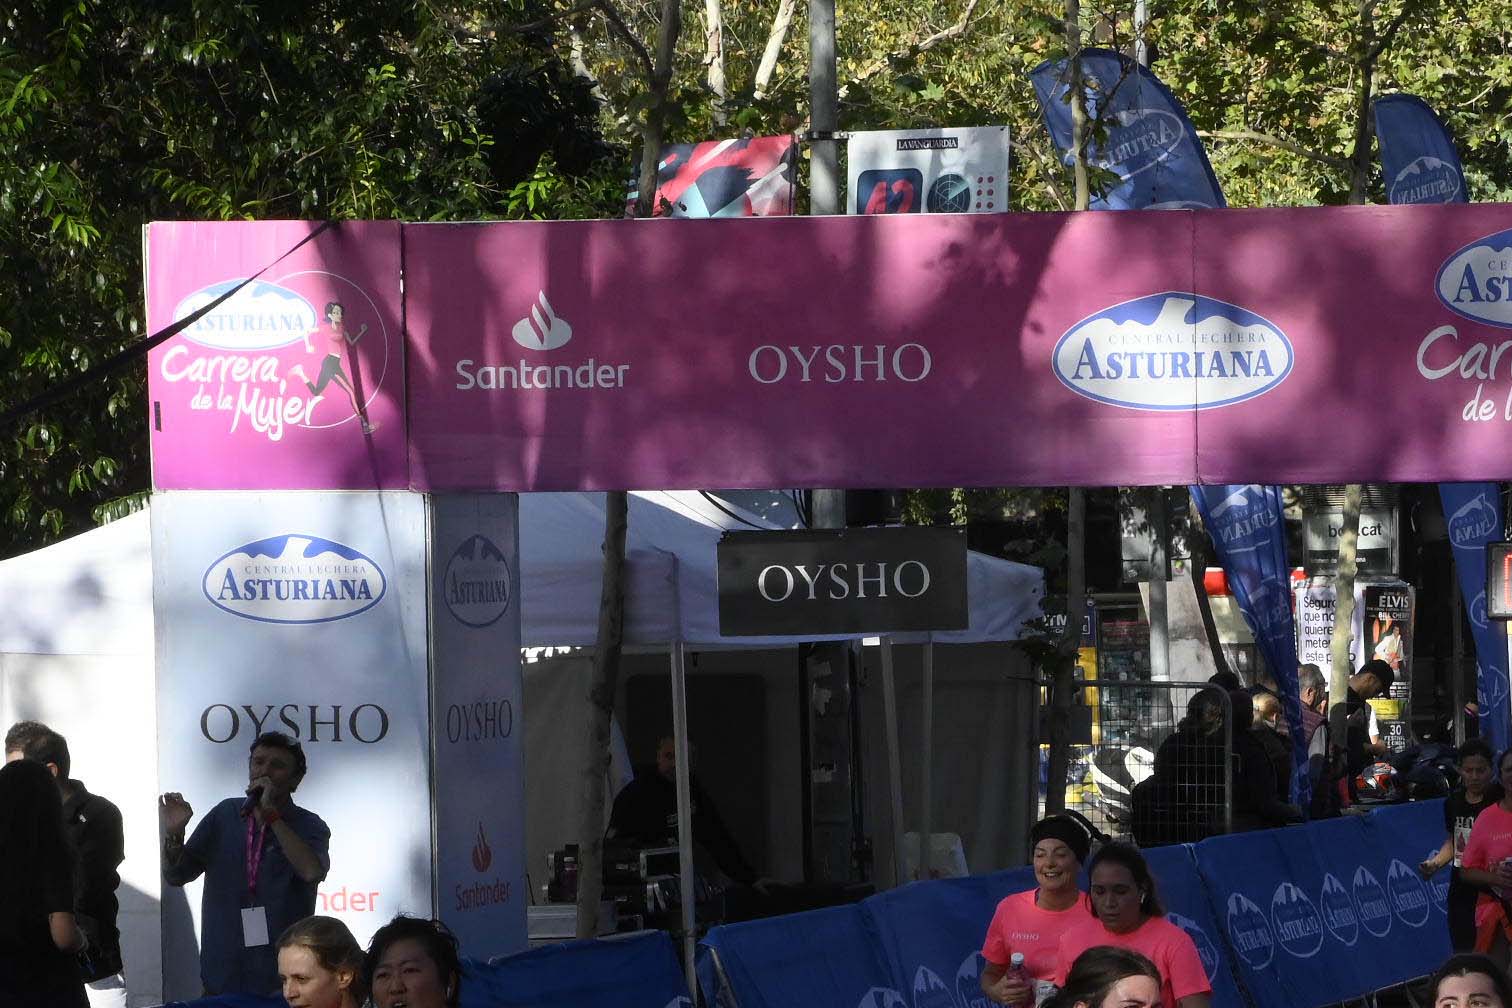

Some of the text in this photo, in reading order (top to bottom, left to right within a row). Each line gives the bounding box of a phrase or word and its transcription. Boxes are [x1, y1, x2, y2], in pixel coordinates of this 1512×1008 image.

[1108, 333, 1183, 346] CENTRAL
[161, 344, 279, 382] Carrera
[456, 357, 630, 390] Santander
[748, 343, 933, 385] OYSHO
[1072, 336, 1274, 381] ASTURIANA
[191, 379, 326, 441] de la Mujer
[1462, 386, 1496, 422] de
[217, 568, 373, 602] ASTURIANA
[244, 565, 367, 575] CENTRAL LECHERA
[757, 560, 931, 602] OYSHO
[450, 572, 507, 605] ASTURIANA
[1379, 595, 1409, 608] ELVIS
[1304, 612, 1320, 622] que
[1305, 624, 1334, 635] quiere
[1306, 653, 1324, 662] este
[200, 704, 389, 744] OYSHO
[447, 699, 512, 744] OYSHO
[455, 881, 511, 910] Santander
